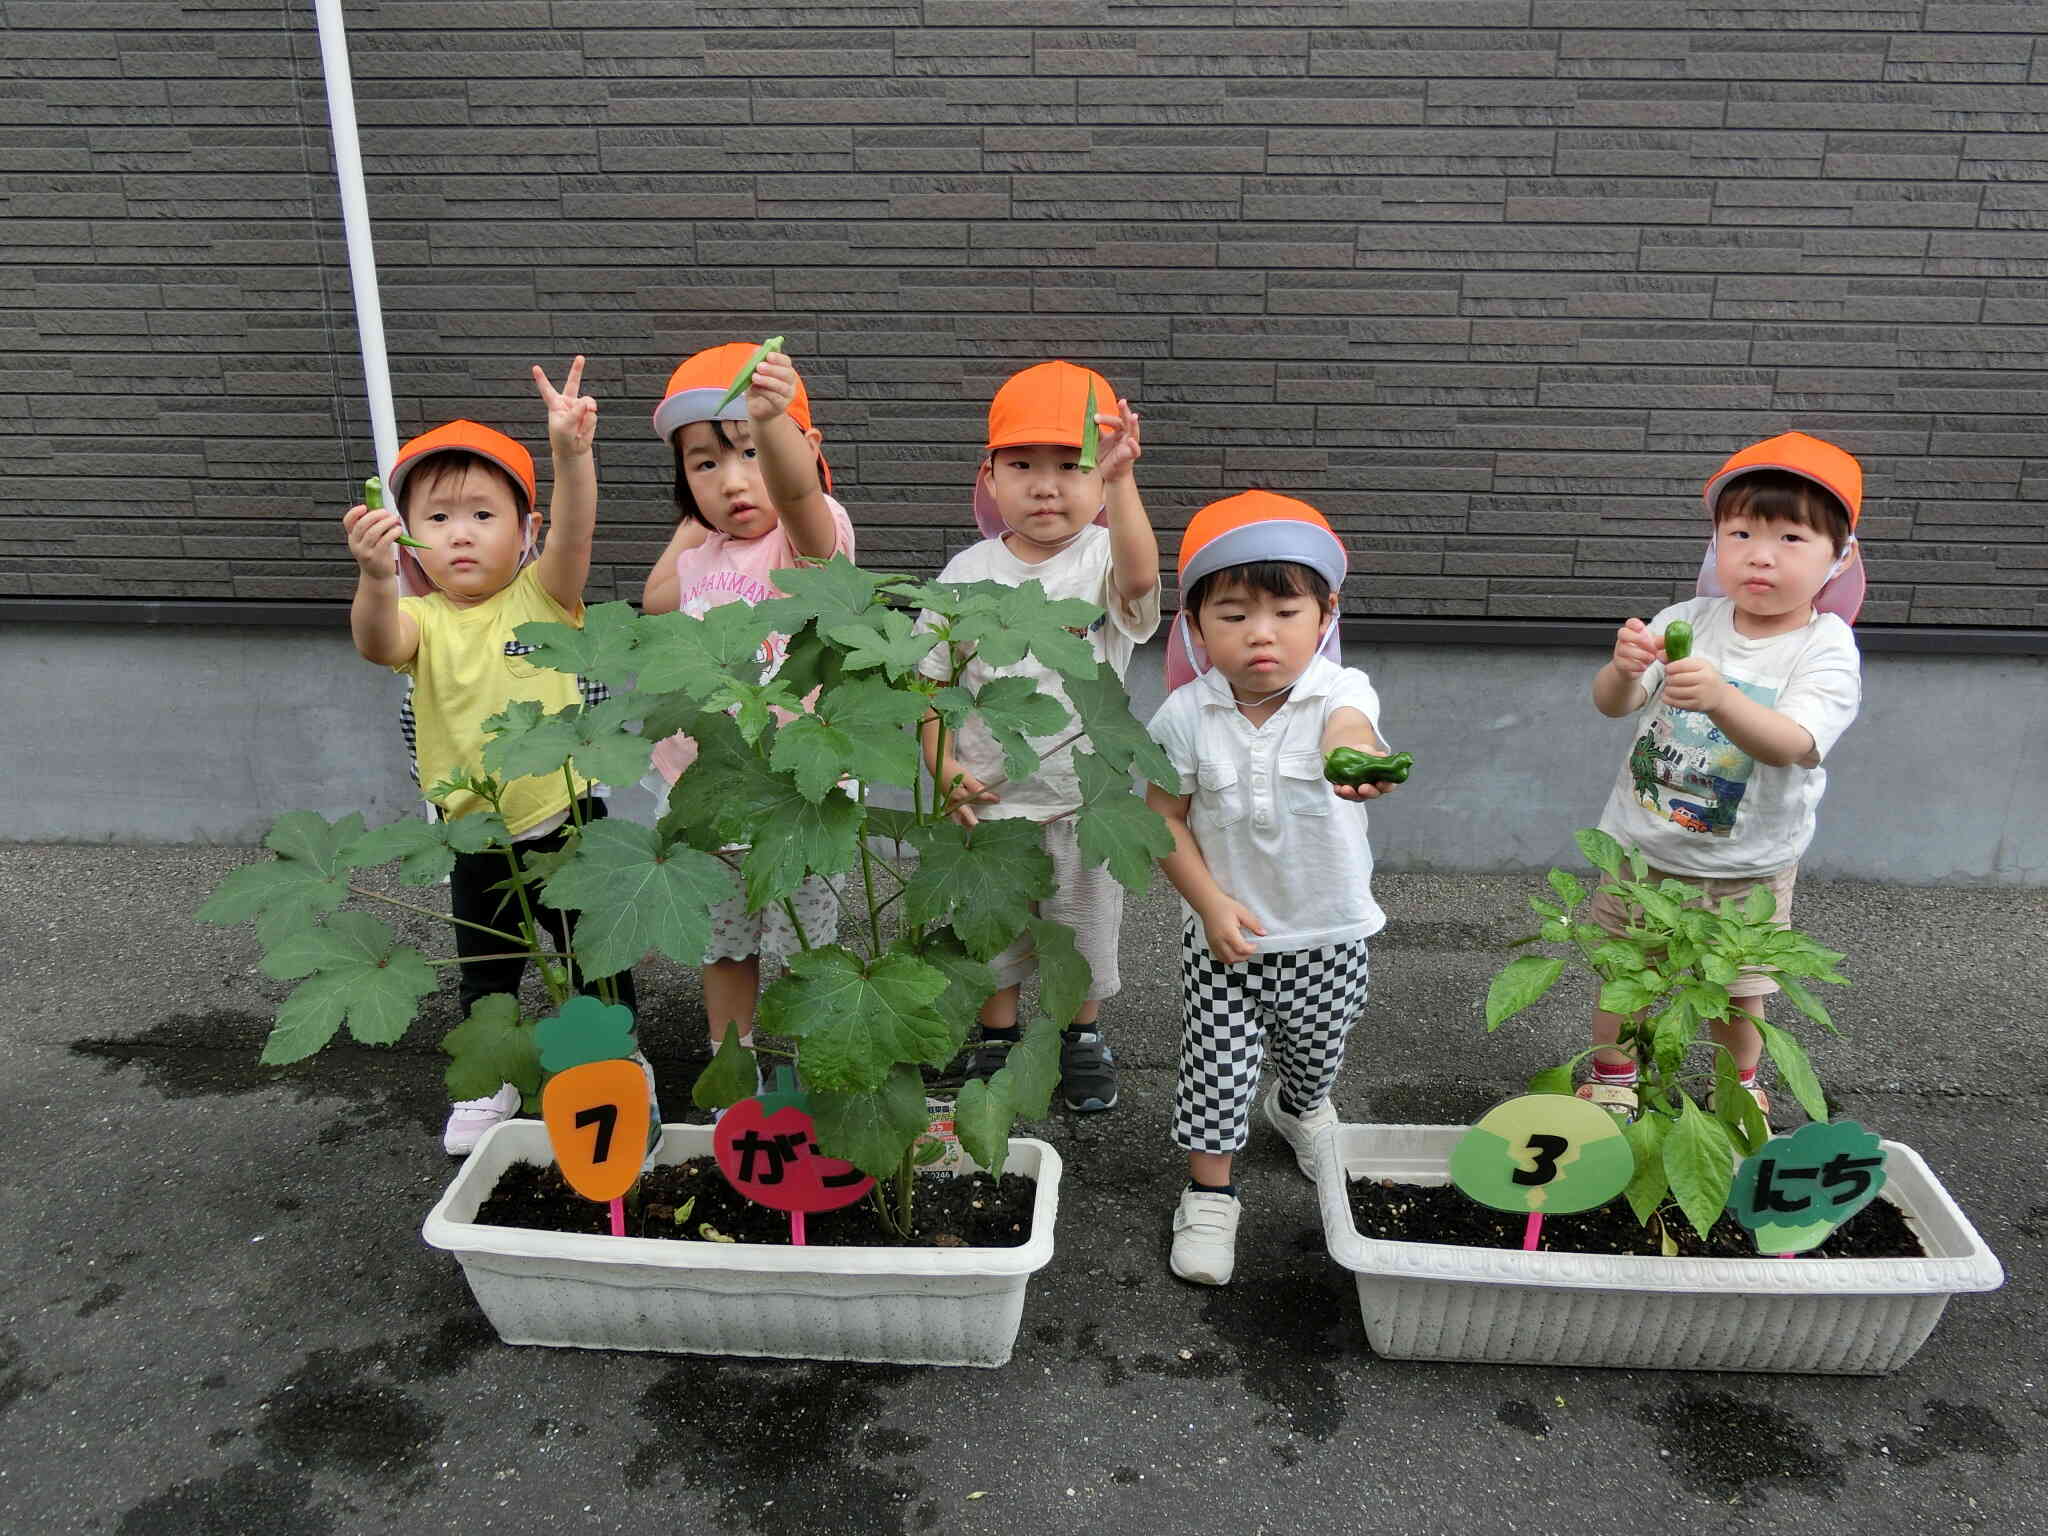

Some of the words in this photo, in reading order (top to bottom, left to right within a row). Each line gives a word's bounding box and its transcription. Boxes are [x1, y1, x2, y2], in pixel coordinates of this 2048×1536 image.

[575, 1103, 618, 1164] 7
[1512, 1134, 1569, 1186] 3
[1752, 1153, 1882, 1213] にち
